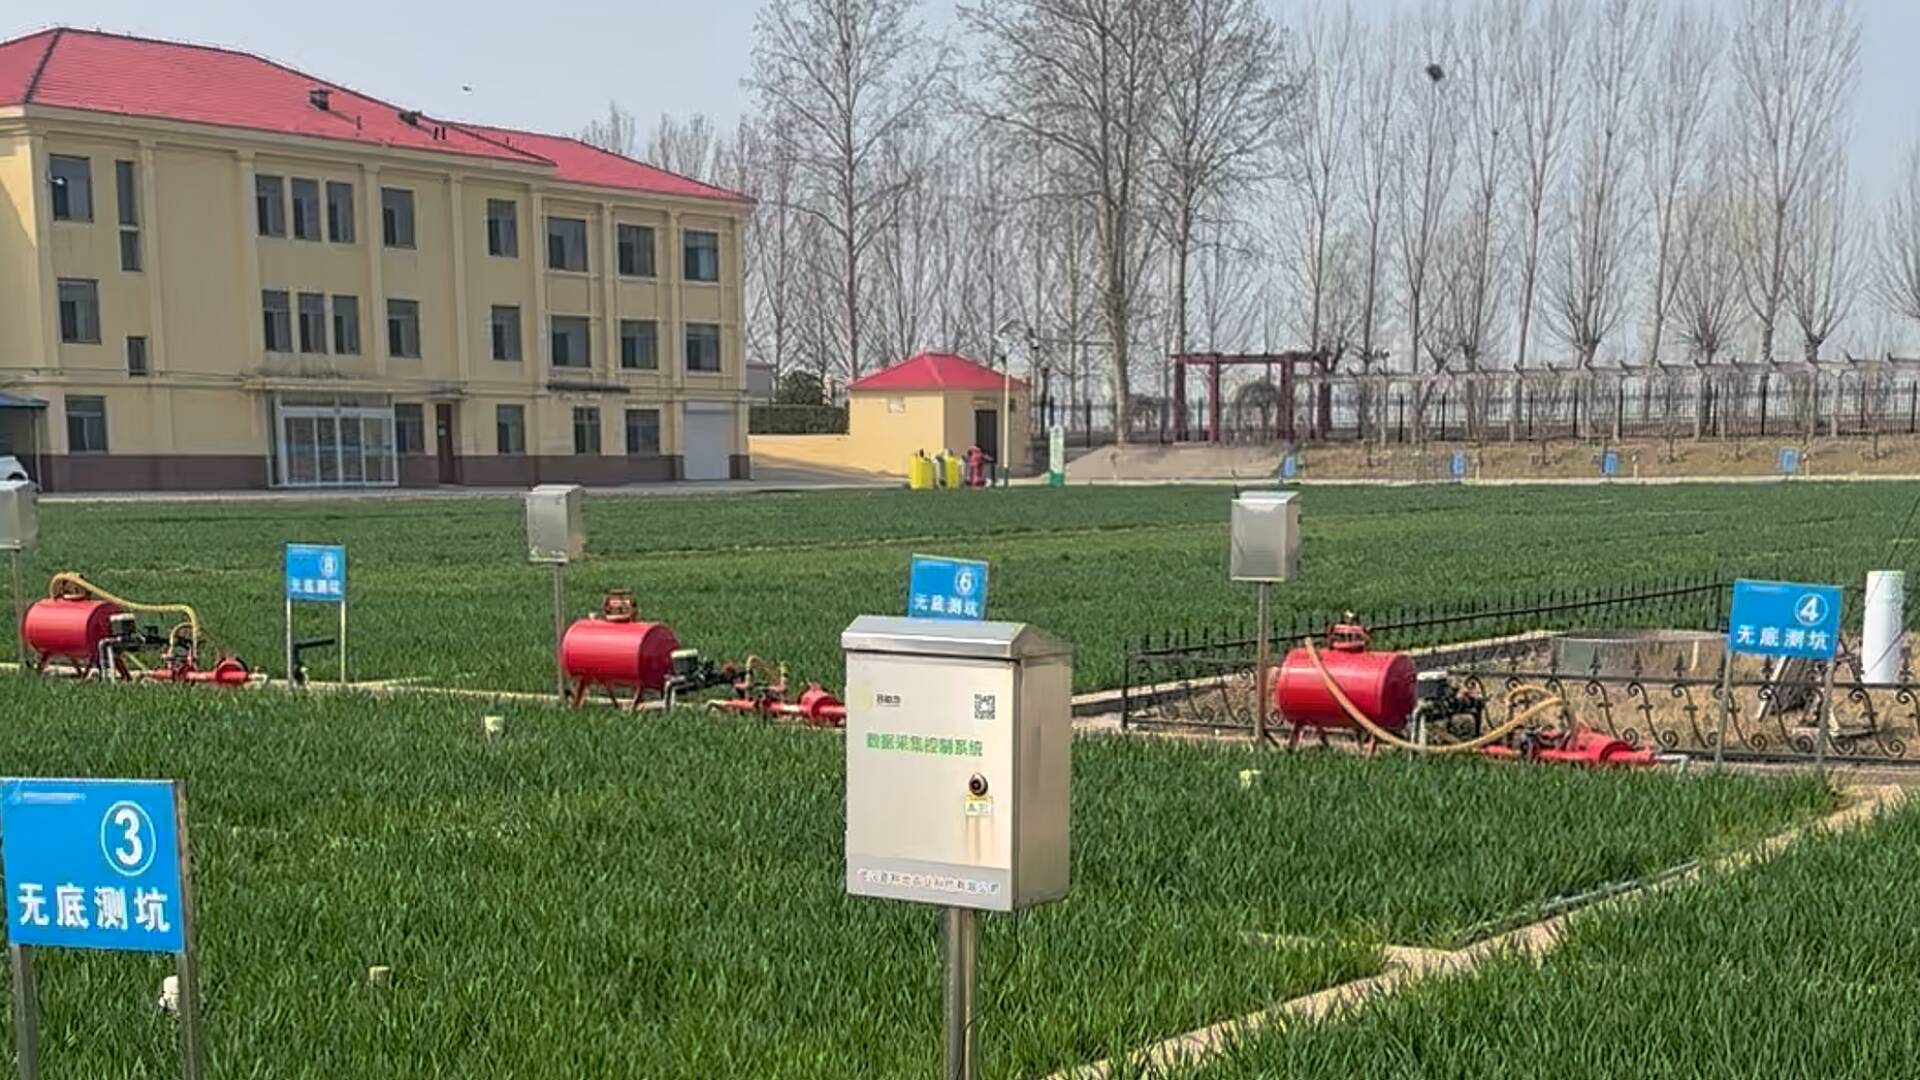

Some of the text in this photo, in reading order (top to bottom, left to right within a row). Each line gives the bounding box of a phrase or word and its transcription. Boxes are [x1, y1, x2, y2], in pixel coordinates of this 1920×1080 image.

[1736, 624, 1830, 650] 无底测坑
[866, 732, 983, 757] 数据采集控制系统
[17, 882, 171, 932] 无底测坑
